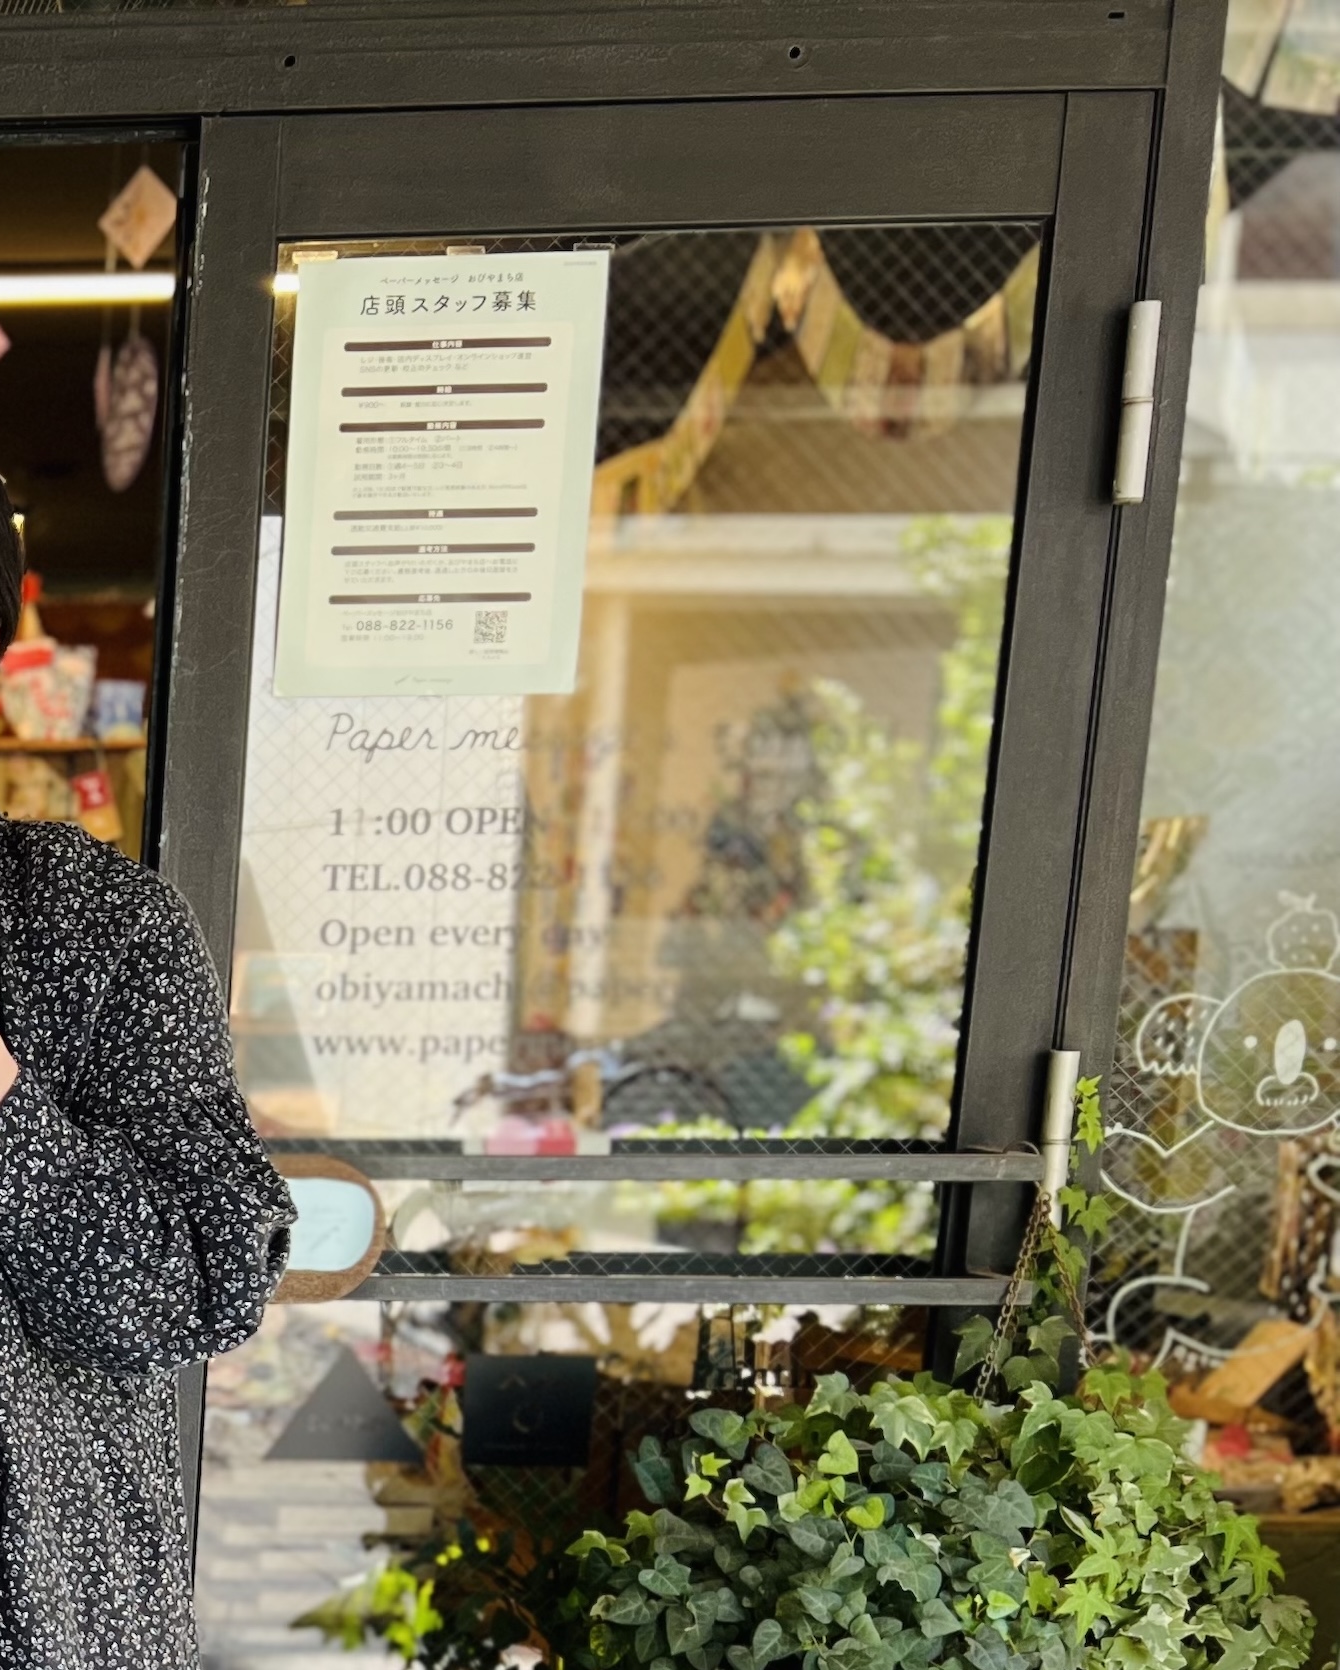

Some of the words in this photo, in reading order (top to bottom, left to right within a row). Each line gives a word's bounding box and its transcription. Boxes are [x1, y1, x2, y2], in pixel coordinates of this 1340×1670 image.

[381, 274, 459, 285] ペーパーメッセージ
[360, 290, 537, 316] 店頭スタッフ募集
[356, 619, 453, 631] 088-822-1156
[326, 712, 439, 764] Paper
[320, 918, 416, 955] Open
